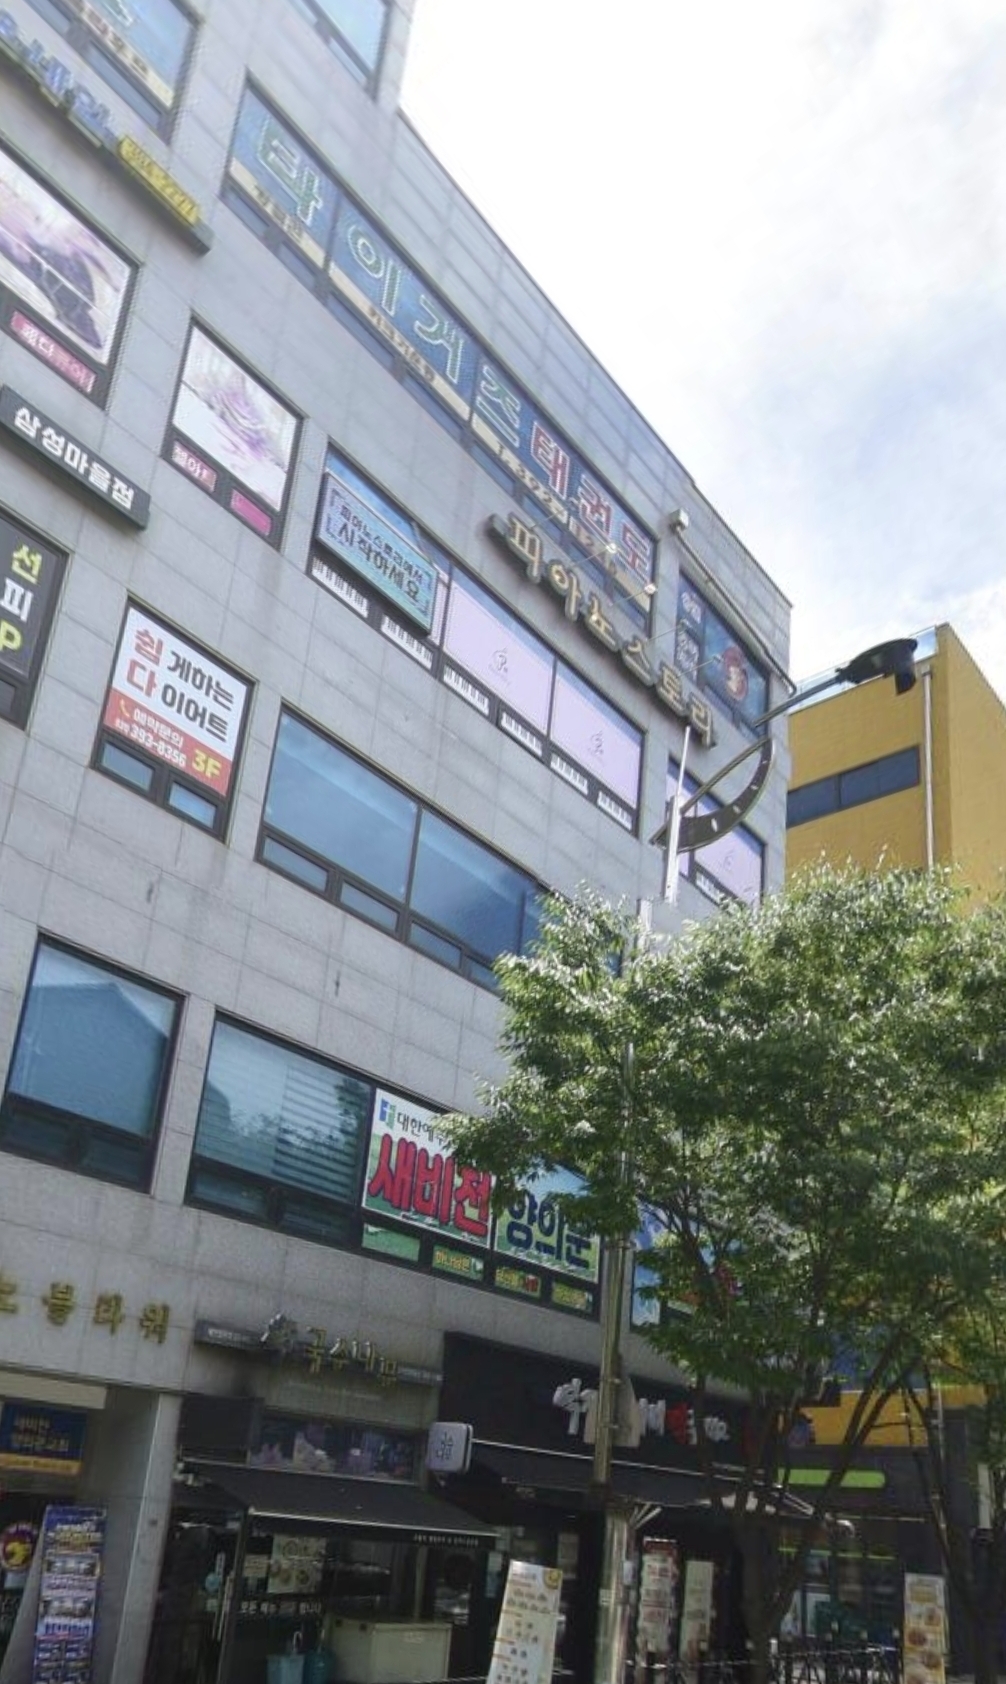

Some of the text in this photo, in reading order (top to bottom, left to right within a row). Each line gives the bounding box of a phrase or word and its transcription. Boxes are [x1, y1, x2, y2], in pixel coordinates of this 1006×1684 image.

[13, 406, 134, 511] 삼성마을점
[338, 522, 421, 603] 시작하세요
[505, 510, 715, 747] 피아노스토리
[126, 659, 229, 743] 다이어트
[192, 748, 222, 779] 3F
[368, 1132, 492, 1240] 새비전
